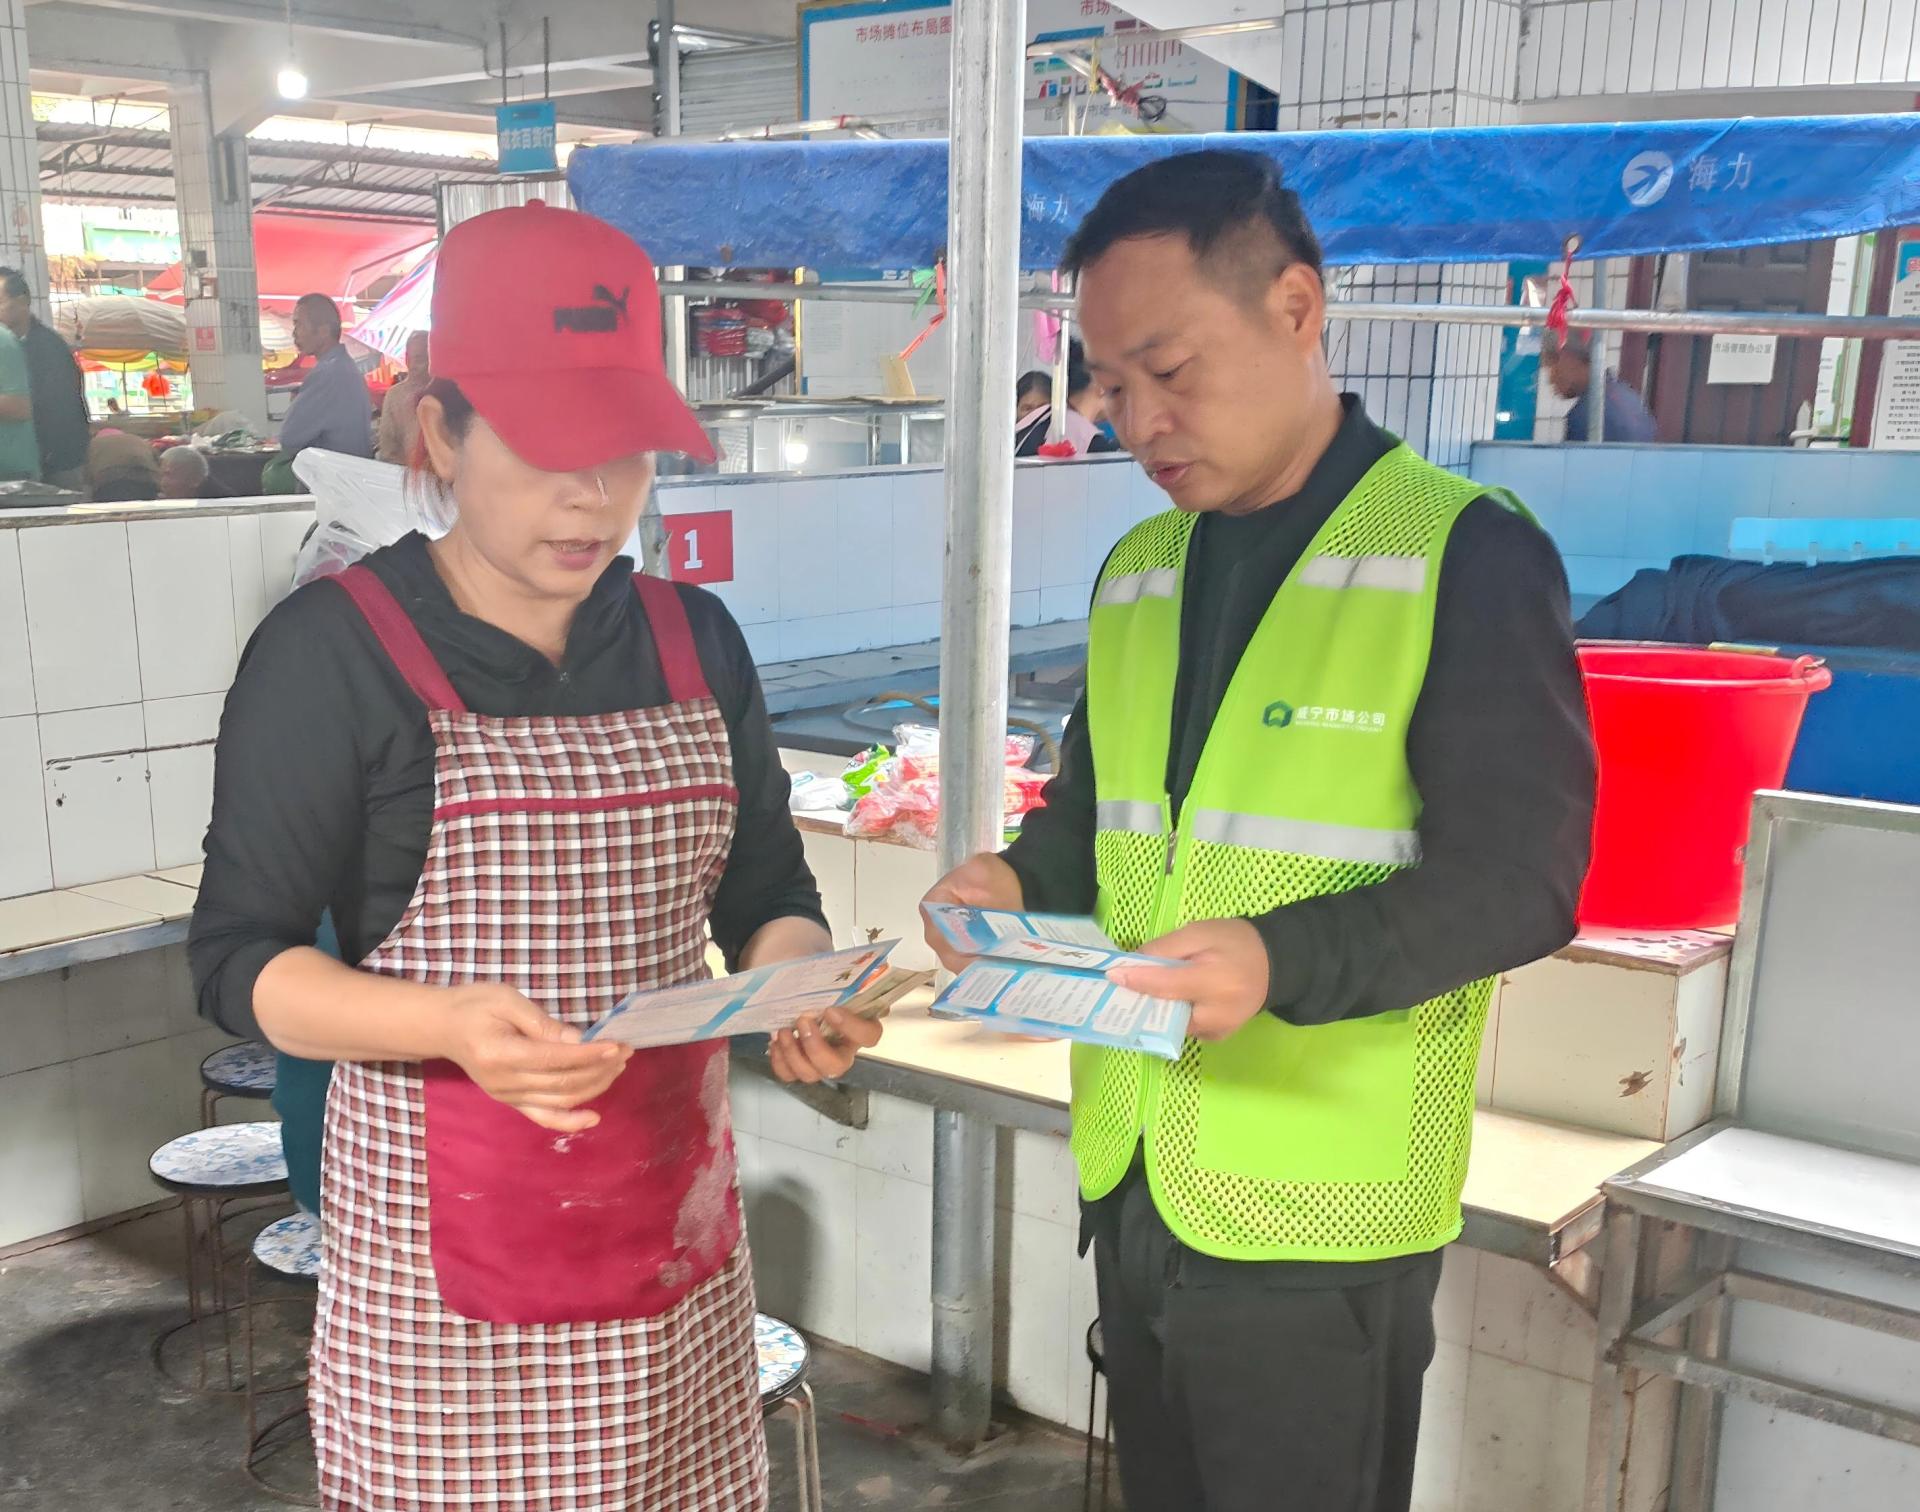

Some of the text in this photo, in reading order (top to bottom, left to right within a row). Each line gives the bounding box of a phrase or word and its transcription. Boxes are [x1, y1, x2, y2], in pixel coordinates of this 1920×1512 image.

[856, 15, 952, 43] 市场摊位布局图
[1688, 152, 1752, 192] 海力
[684, 529, 703, 569] 1
